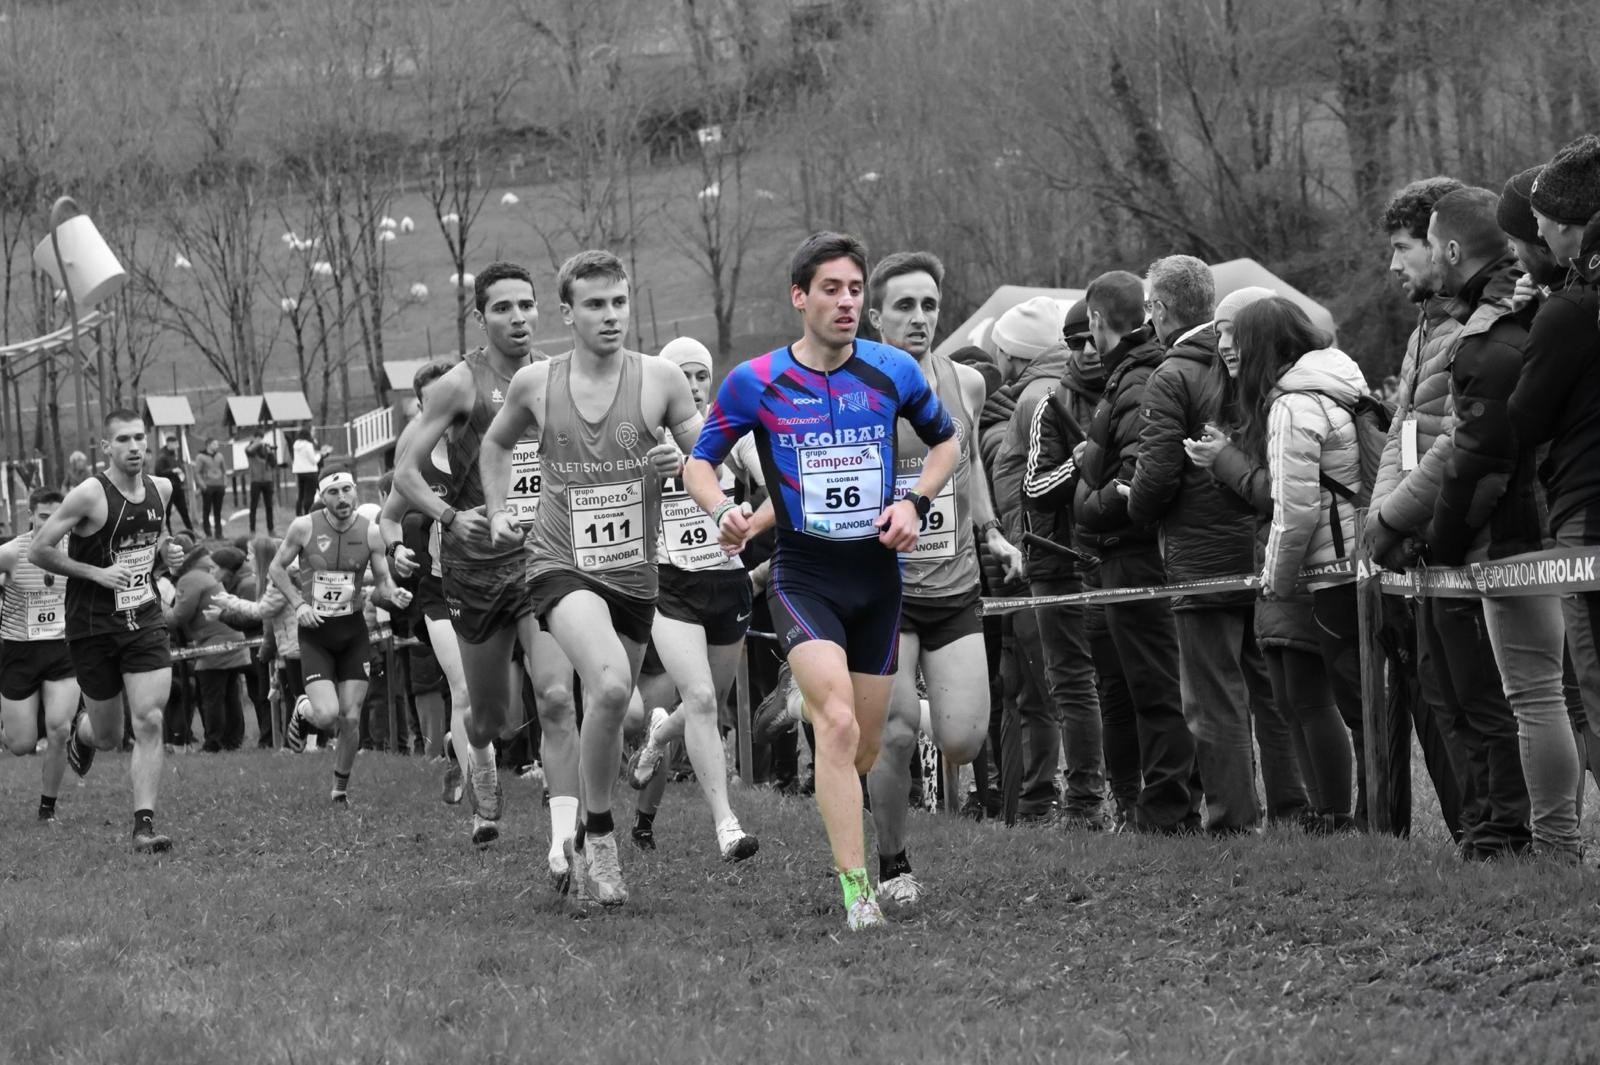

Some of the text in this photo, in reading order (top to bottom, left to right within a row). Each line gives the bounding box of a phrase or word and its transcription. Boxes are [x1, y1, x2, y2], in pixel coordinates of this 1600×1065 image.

[805, 450, 827, 458] grupo
[616, 456, 649, 470] EIBAR
[806, 455, 863, 469] campezo
[513, 475, 542, 494] 48
[826, 475, 859, 484] ELGOIBAR
[574, 488, 594, 496] grupo
[825, 486, 861, 509] 56
[575, 493, 628, 506] campezo
[593, 511, 625, 520] ELGOIBAR
[664, 505, 703, 517] campez
[584, 518, 631, 544] 111
[835, 518, 874, 531] DANOBAT
[680, 527, 708, 545] 49
[914, 540, 949, 552] ANOBAT
[598, 548, 640, 563] DANOBAT
[1484, 556, 1596, 588] GIPUZKOA KIROLAK
[323, 591, 342, 601] 47
[37, 612, 56, 623] 60
